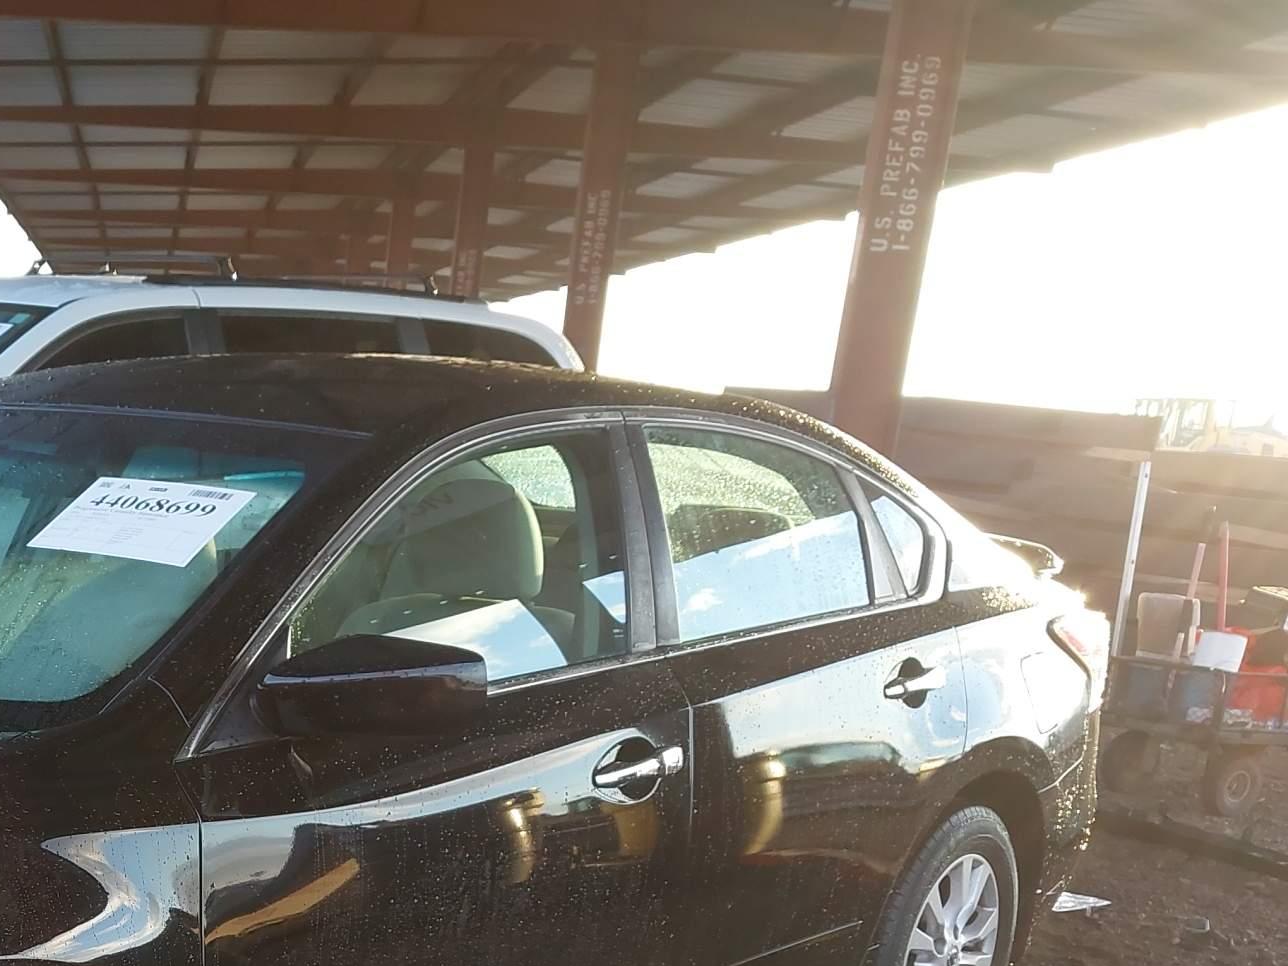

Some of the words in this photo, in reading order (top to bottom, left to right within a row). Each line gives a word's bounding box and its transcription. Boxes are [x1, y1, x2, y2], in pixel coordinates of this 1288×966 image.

[897, 53, 922, 96] INC.
[880, 107, 912, 197] PREFAB
[891, 55, 942, 252] 1-866-799-0969
[869, 209, 895, 252] U.S.
[89, 492, 217, 518] 44068699
